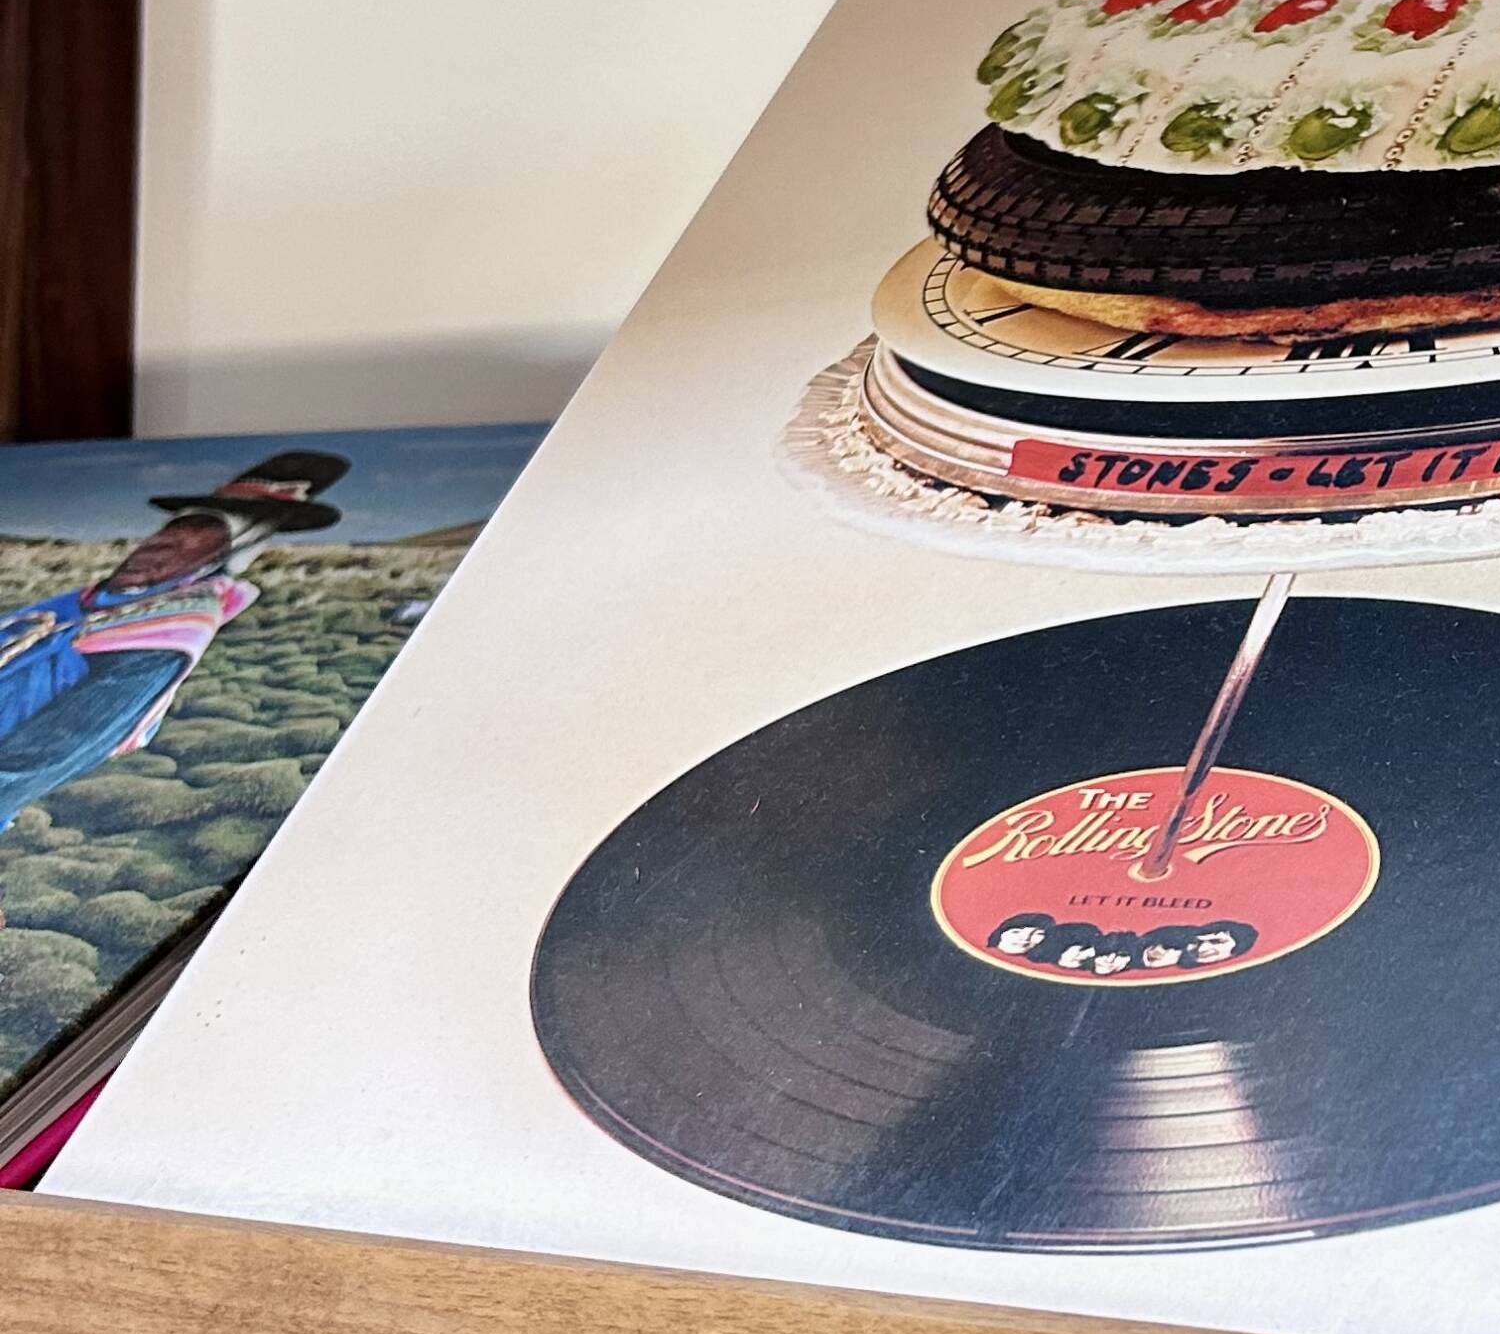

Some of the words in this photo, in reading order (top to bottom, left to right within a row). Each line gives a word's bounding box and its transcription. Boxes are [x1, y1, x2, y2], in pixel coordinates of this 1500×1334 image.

[1058, 452, 1260, 493] STONES
[1306, 452, 1413, 489] LET
[1421, 445, 1491, 482] IT
[1078, 788, 1154, 811] THE
[963, 810, 1160, 868] Rolling
[1177, 792, 1330, 865] Stones
[1068, 895, 1111, 907] LET
[1116, 896, 1137, 907] IT
[1142, 897, 1213, 909] BLEED
